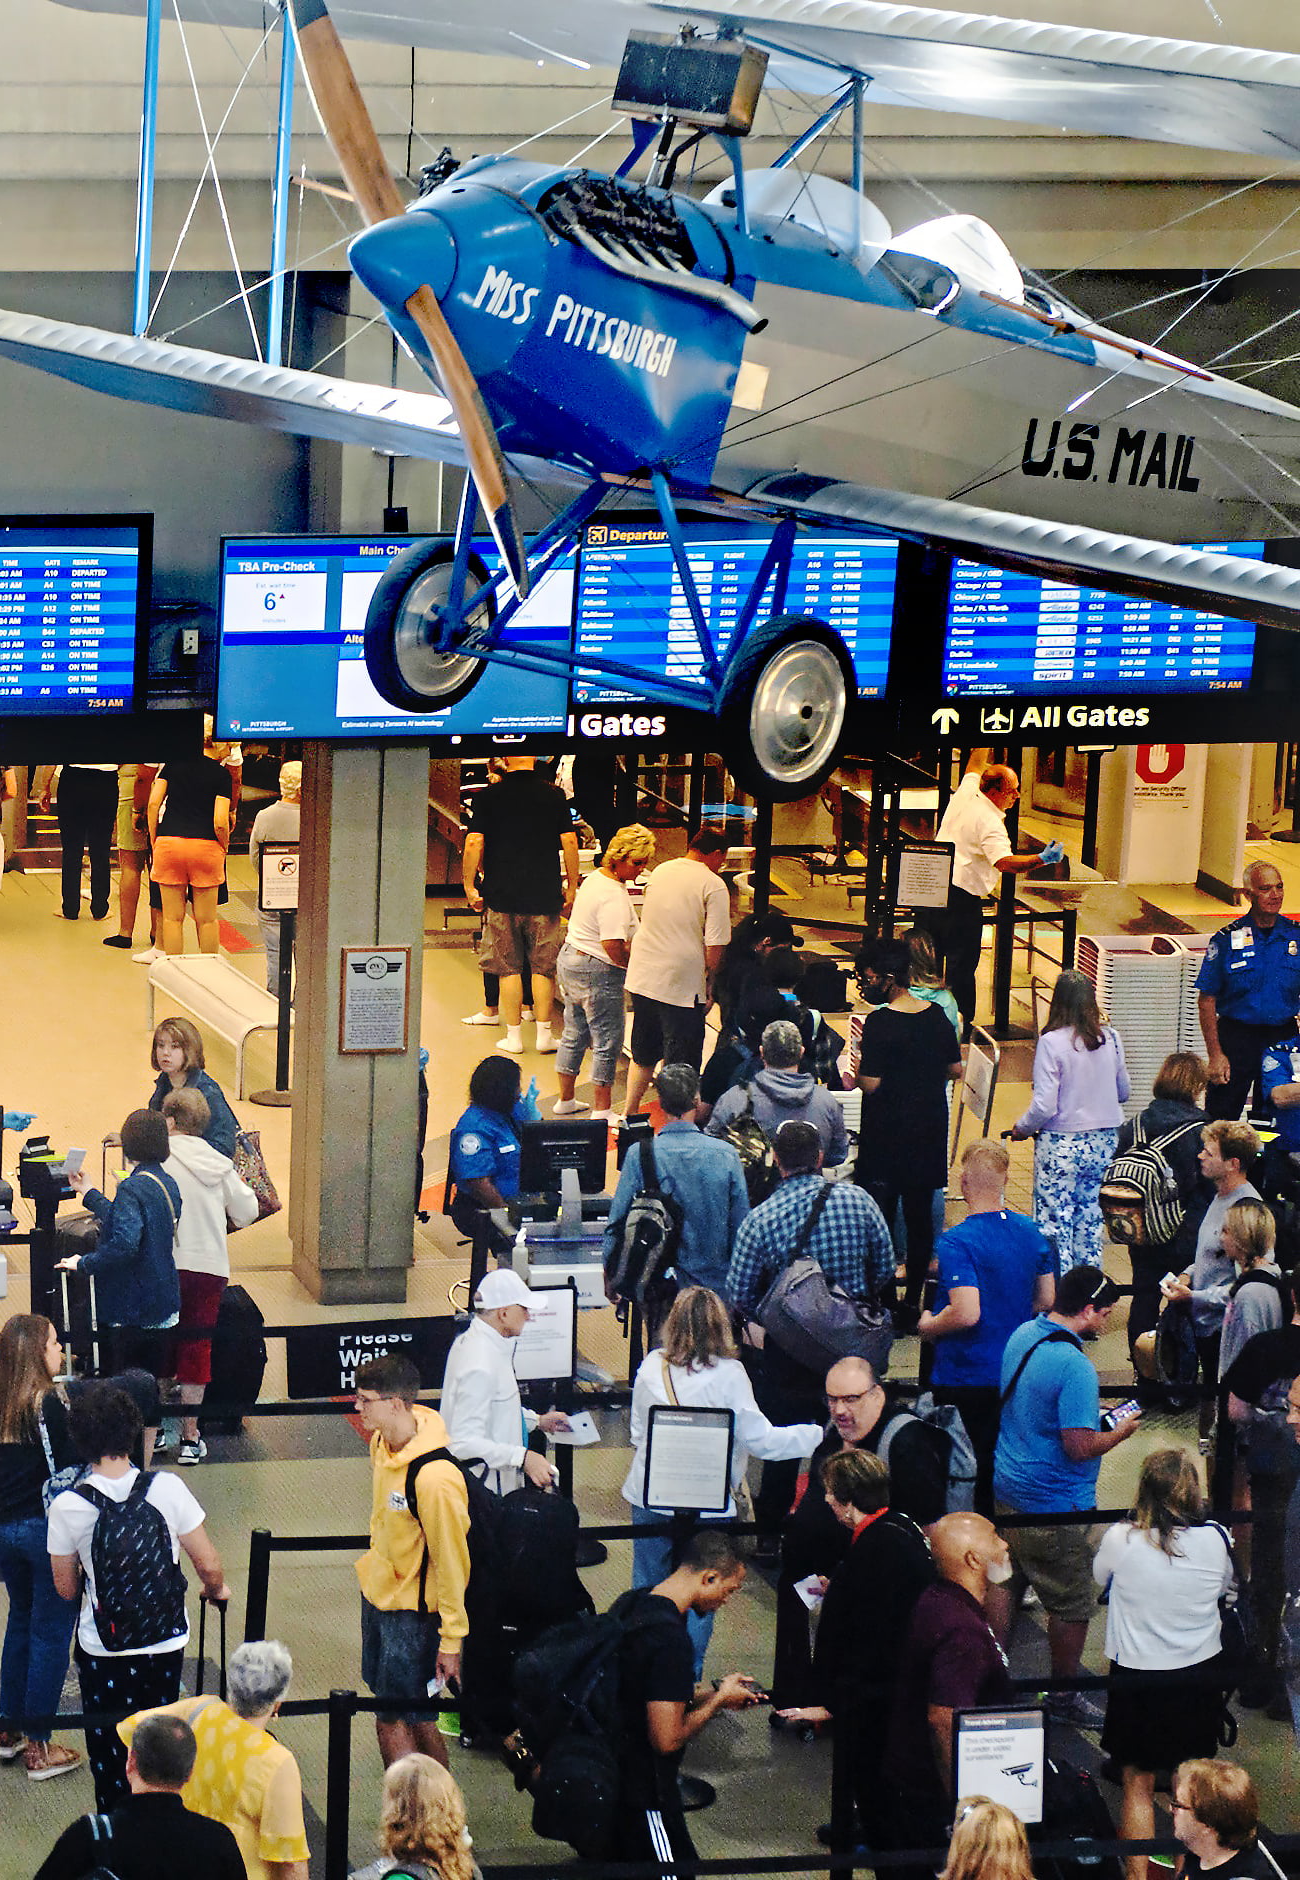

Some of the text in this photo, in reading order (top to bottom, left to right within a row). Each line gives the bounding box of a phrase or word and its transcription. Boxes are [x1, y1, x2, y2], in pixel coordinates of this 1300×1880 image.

[474, 264, 678, 378] MISS PITTSBURGH
[1022, 418, 1201, 493] U.S. MAIL
[610, 530, 668, 543] Departur
[359, 545, 384, 555] Main
[238, 561, 315, 572] TSA Pre-Check
[264, 592, 276, 611] 6
[1208, 681, 1226, 689] 7:54
[581, 714, 666, 737] Gates
[1020, 705, 1150, 728] All Gates
